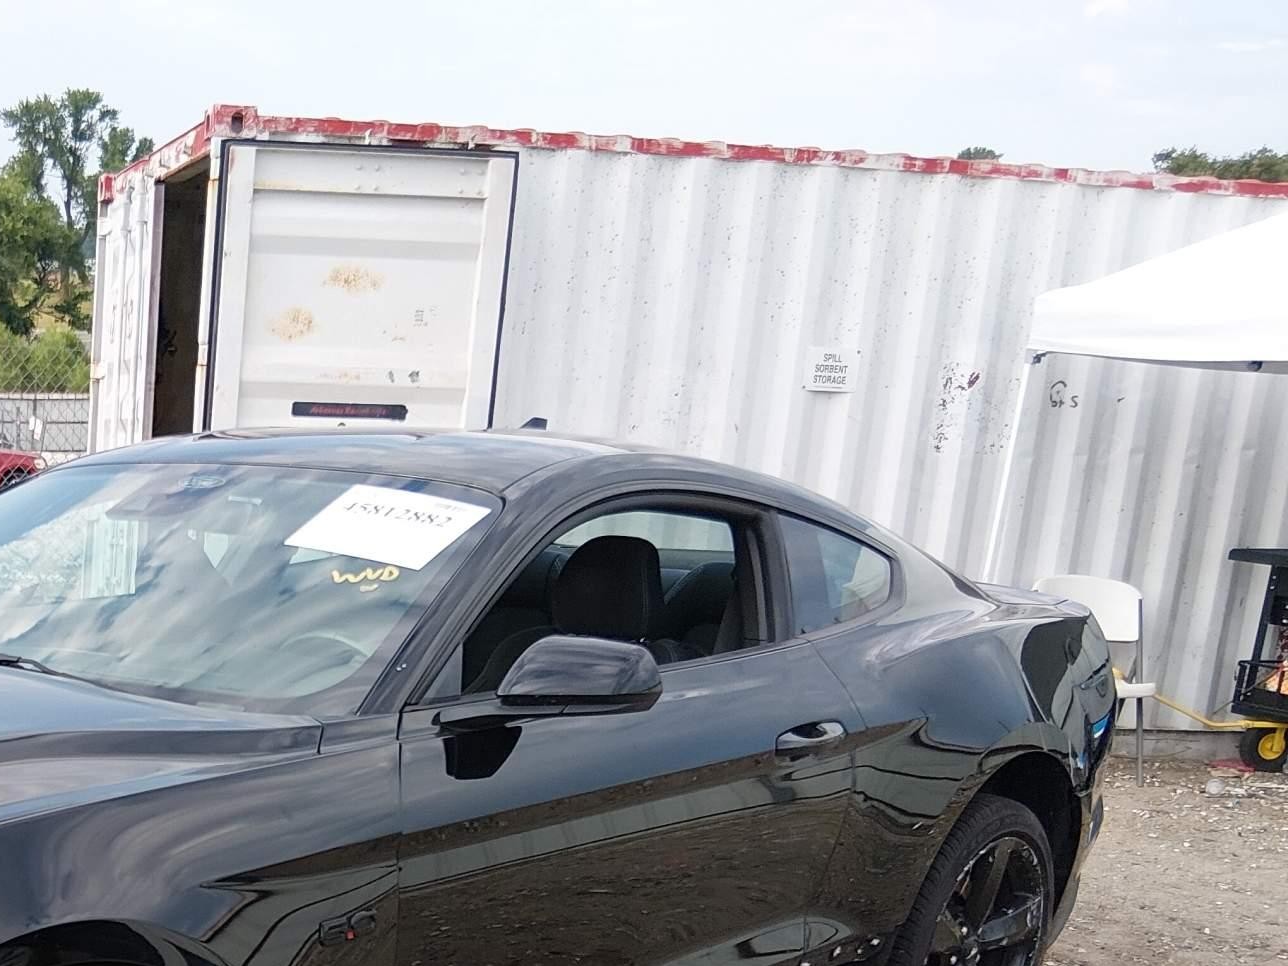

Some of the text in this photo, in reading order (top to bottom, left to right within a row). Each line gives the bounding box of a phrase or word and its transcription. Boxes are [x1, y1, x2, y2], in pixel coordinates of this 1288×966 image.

[823, 353, 843, 363] SPILL
[814, 364, 849, 374] SORBENT
[813, 375, 847, 385] STORAGE
